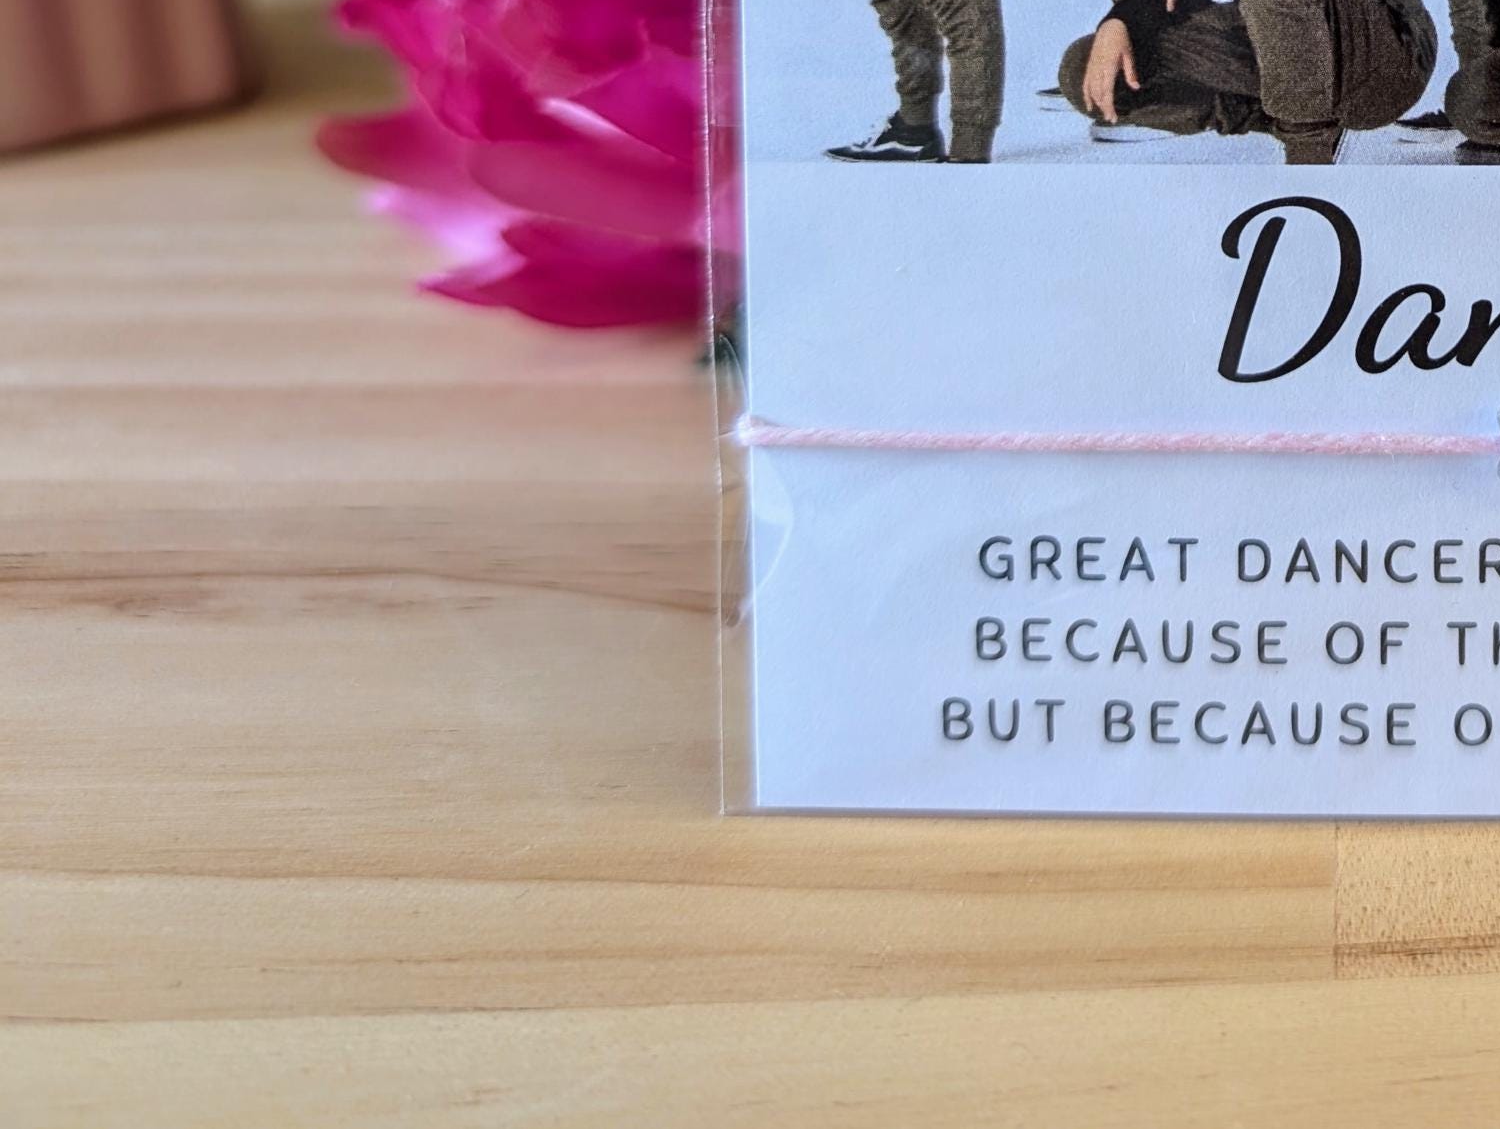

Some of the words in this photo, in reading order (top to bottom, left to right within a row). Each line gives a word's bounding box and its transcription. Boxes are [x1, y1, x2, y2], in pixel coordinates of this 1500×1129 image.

[977, 534, 1199, 584] GREAT
[974, 617, 1288, 666] BECAUSE
[1324, 621, 1410, 667] OF
[941, 697, 1066, 744] BUT
[1103, 699, 1417, 748] BECAUSE
